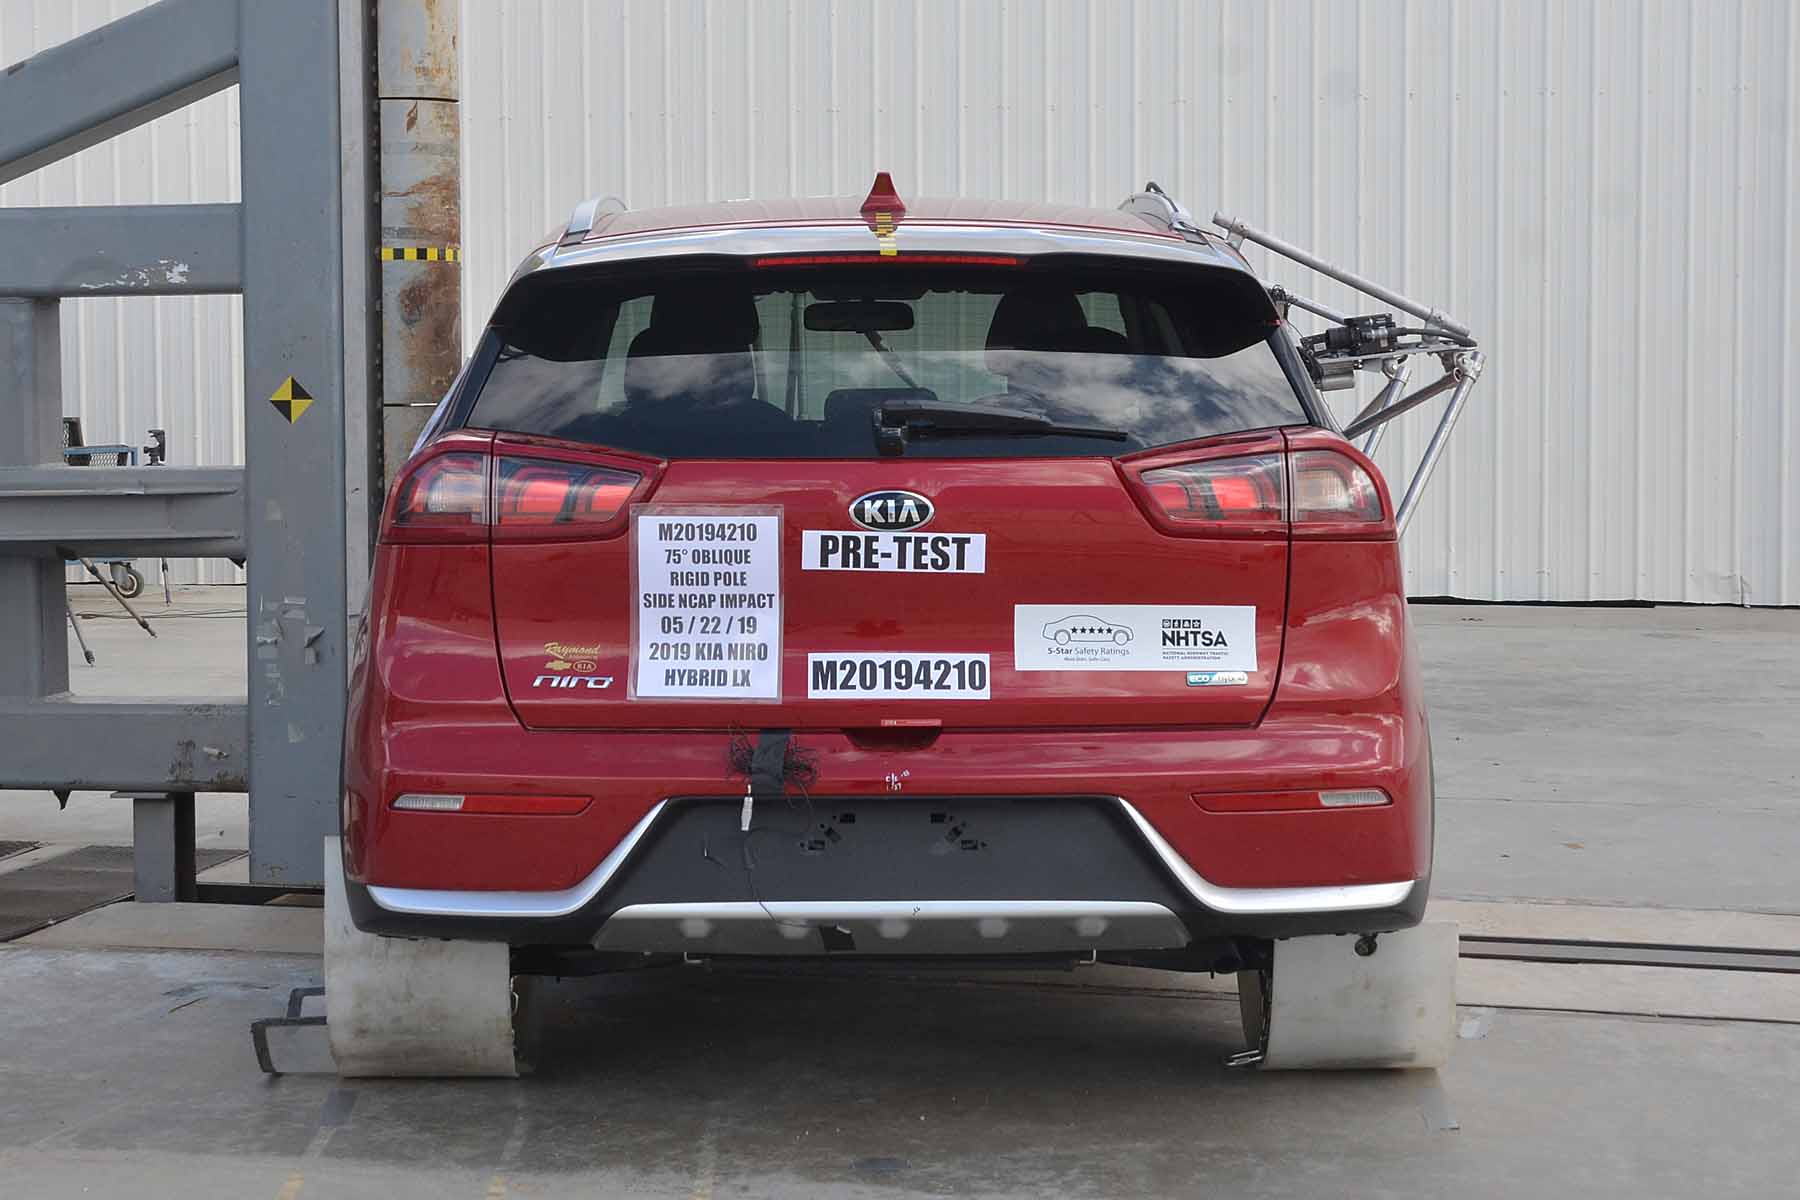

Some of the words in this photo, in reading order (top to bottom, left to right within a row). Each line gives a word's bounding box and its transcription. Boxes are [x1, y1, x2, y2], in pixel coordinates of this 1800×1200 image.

[863, 499, 921, 523] KIA
[658, 523, 757, 541] M20194210
[665, 549, 688, 564] 75°
[692, 549, 751, 566] OBLIQUE
[819, 534, 971, 571] PRE-TEST
[670, 571, 710, 586] RIGID
[714, 571, 747, 586] POLE
[643, 593, 675, 608] SIDE
[678, 593, 716, 608] NCAP
[720, 593, 775, 608] IMPACT
[1161, 630, 1228, 647] NHTSA
[544, 642, 600, 659] Raymond
[649, 642, 691, 661] 2019
[695, 642, 724, 661] KIA
[727, 642, 768, 661] NIRO
[1047, 647, 1073, 655] 5-Star
[1074, 647, 1099, 656] Safety
[1100, 647, 1130, 656] Ratings
[664, 669, 728, 687] HYBRID
[732, 669, 751, 687] LX
[812, 659, 987, 691] M20194210
